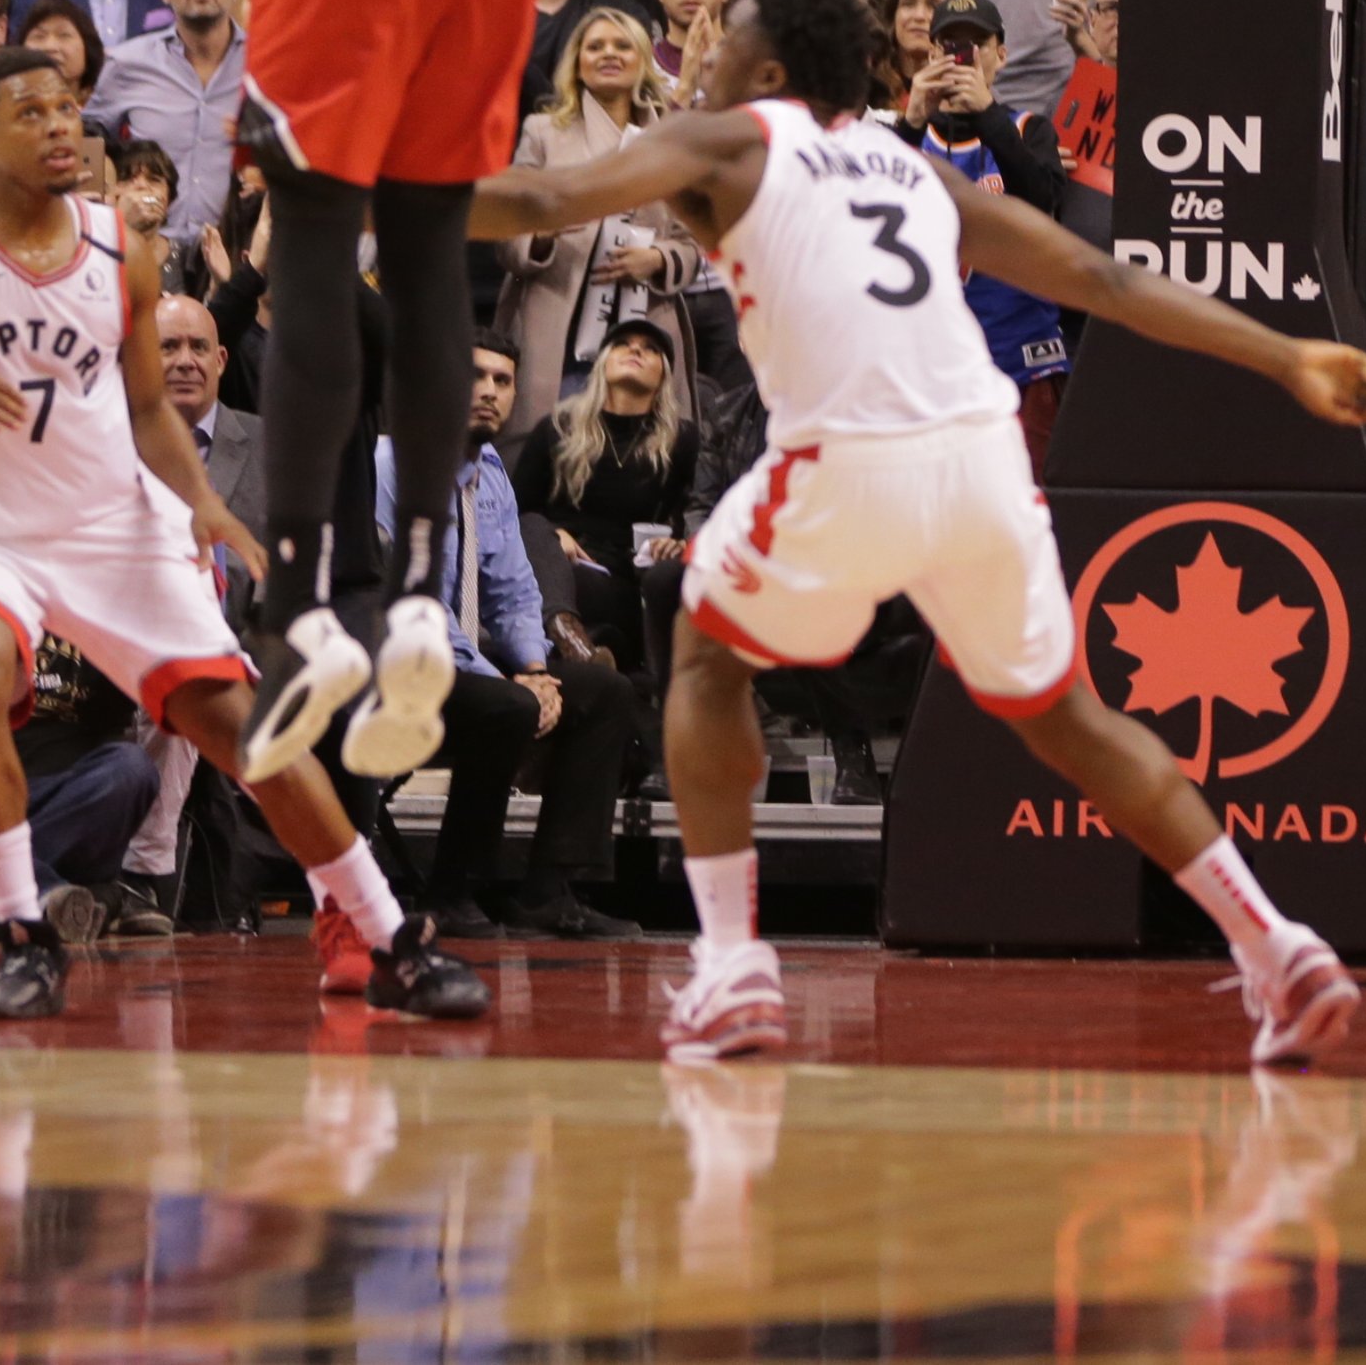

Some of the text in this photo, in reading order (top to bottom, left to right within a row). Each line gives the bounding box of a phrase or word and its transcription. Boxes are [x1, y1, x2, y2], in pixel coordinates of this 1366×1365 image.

[1142, 113, 1262, 174] ON
[1170, 190, 1225, 221] the
[849, 200, 931, 307] 3
[19, 378, 56, 445] 7
[1006, 798, 1114, 838] AIR
